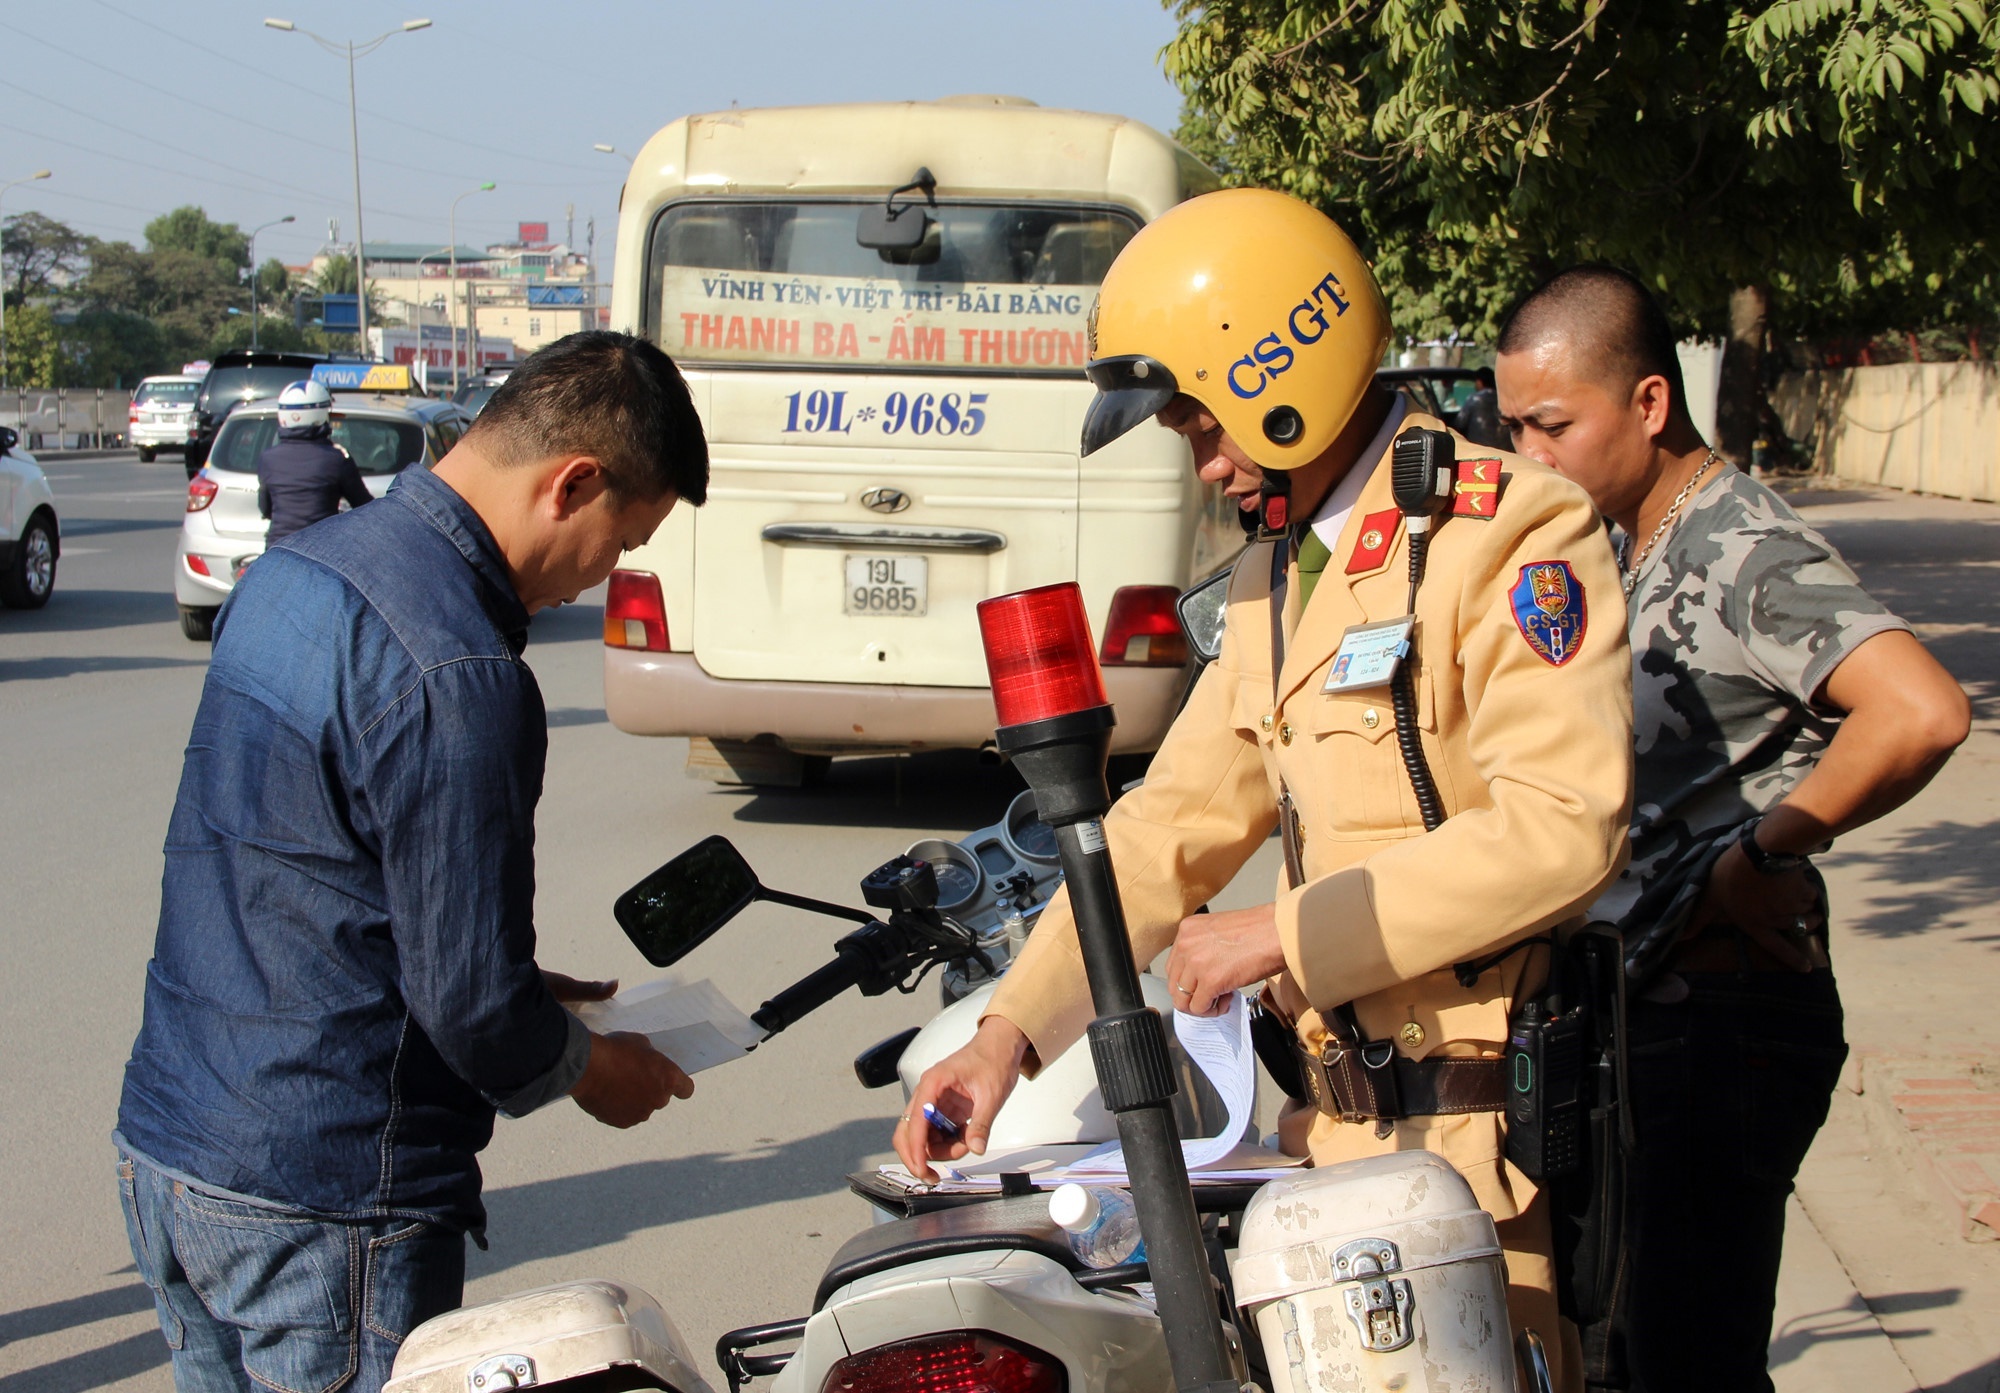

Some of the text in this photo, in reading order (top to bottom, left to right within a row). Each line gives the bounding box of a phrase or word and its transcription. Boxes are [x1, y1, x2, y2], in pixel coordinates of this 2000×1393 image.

[702, 272, 764, 302] VĨNH
[772, 277, 822, 305] YÊN
[835, 281, 893, 313] VIỆT
[901, 284, 942, 312] TRÌ
[957, 286, 1002, 313] BÃI
[1009, 285, 1082, 315] BẰNG
[681, 312, 800, 354] THANH
[813, 321, 860, 358] BA
[887, 312, 945, 362] ẤM
[959, 327, 1092, 366] THƯƠN
[1227, 271, 1350, 399] CSGT
[362, 371, 397, 385] TAXI
[866, 559, 906, 585] 19L
[853, 586, 917, 611] 9685
